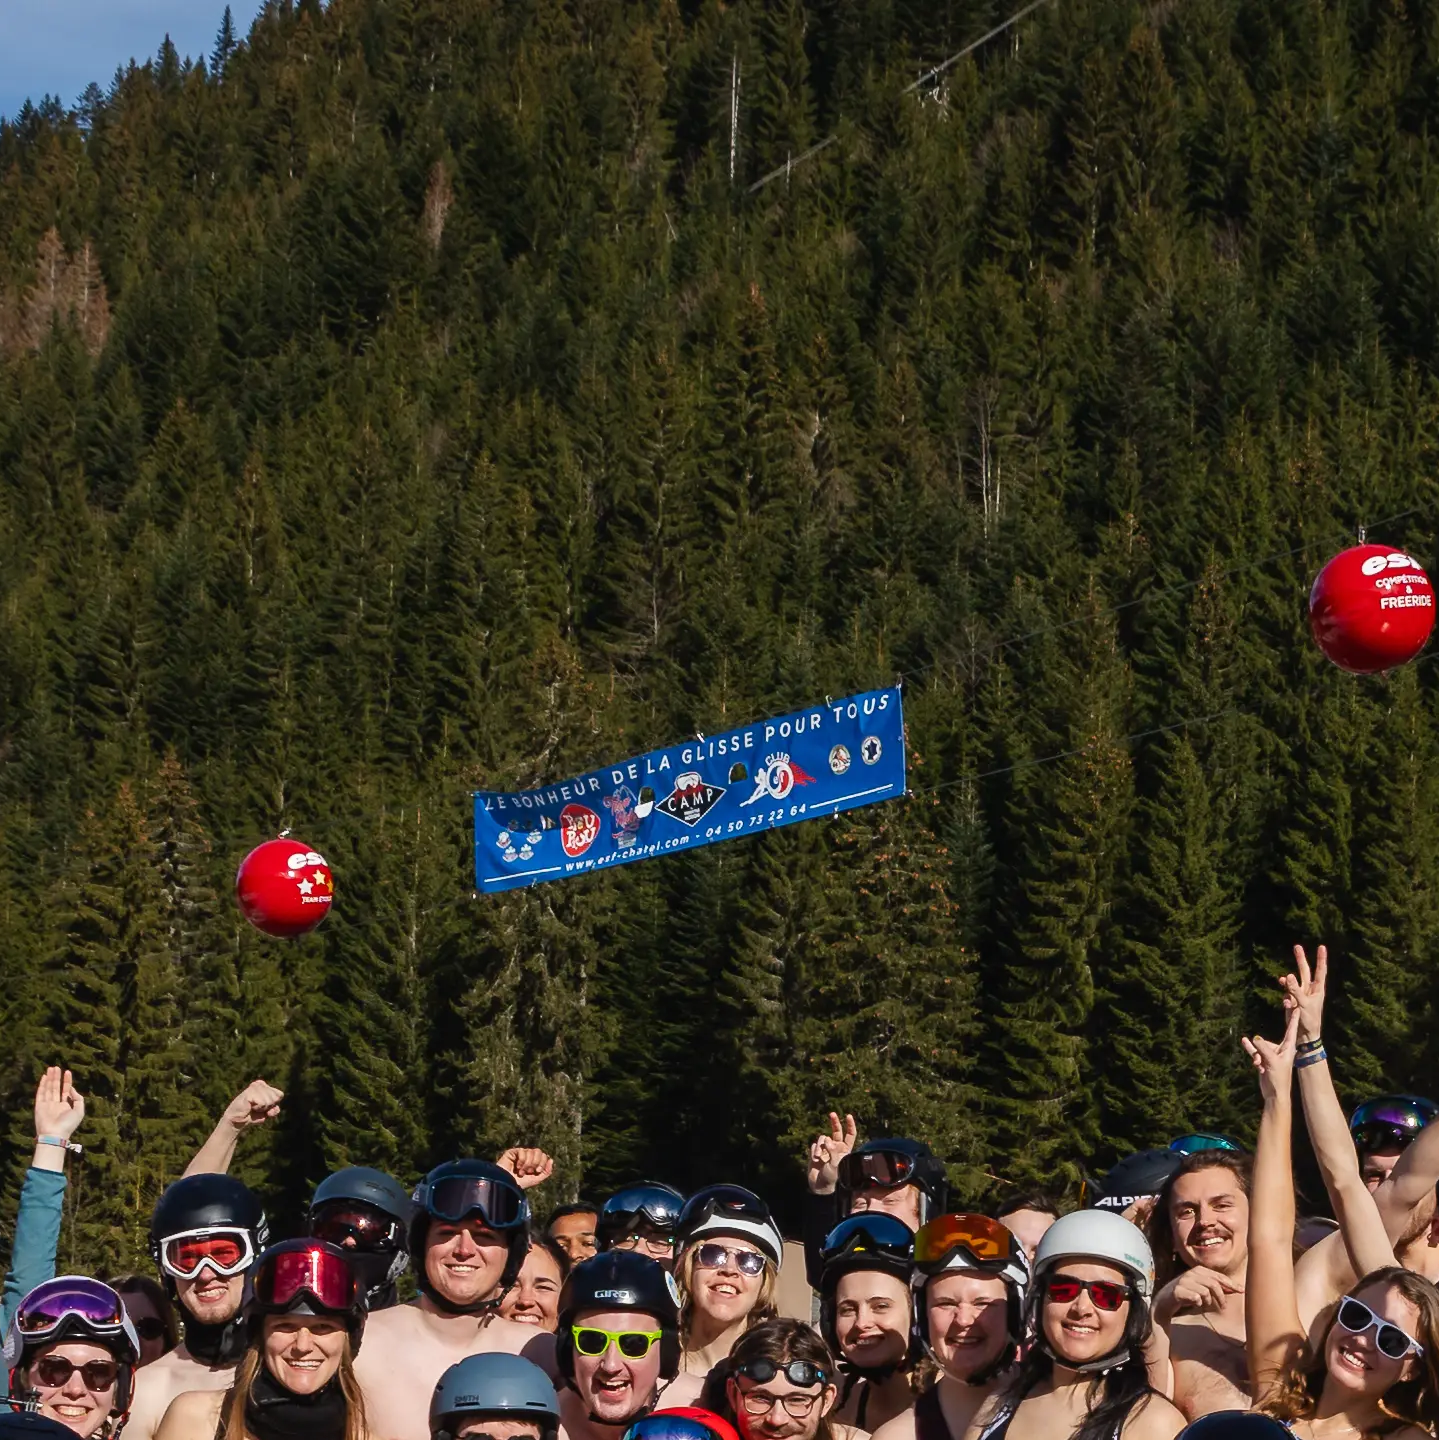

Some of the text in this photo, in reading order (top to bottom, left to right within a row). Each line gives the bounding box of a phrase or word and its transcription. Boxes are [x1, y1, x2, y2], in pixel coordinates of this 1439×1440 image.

[1380, 595, 1432, 610] FREERIDE
[485, 695, 889, 811] LE BONHEUR DE LA GLISSE POUR TOUS
[765, 752, 791, 766] CLUB
[668, 790, 713, 812] CAMP
[706, 826, 721, 838] 04
[727, 820, 743, 833] 50
[748, 815, 763, 827] 73
[768, 811, 784, 823] 22
[790, 804, 806, 816] 64
[594, 1289, 630, 1299] GIRO
